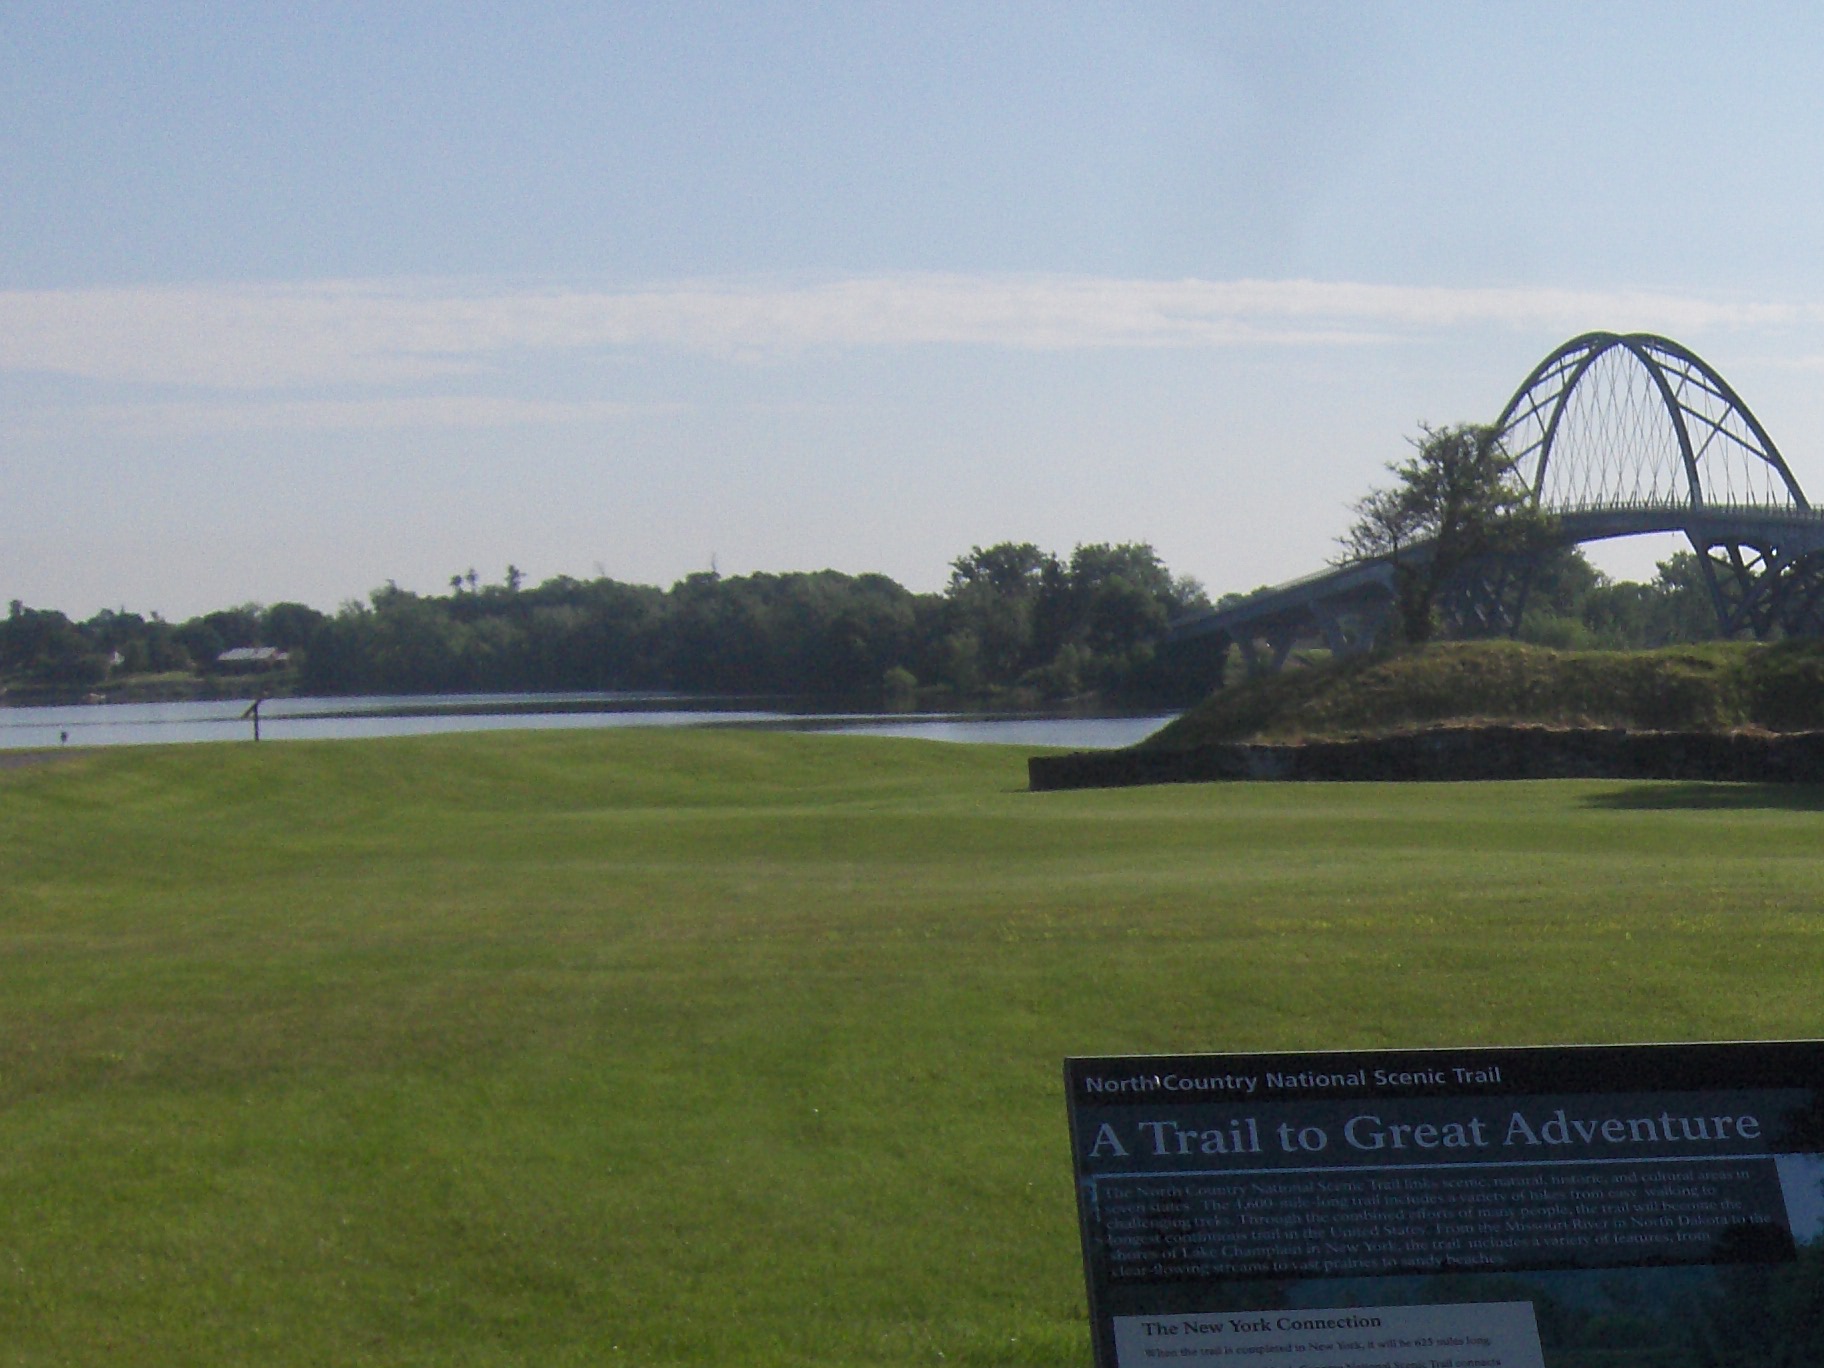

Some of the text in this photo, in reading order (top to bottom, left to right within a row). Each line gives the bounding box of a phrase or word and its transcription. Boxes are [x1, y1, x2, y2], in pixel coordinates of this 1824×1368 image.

[1086, 1065, 1501, 1093] North Country National Scenic Trail
[1088, 1109, 1761, 1158] A Trail to Great Adventure
[1105, 1176, 1547, 1199] The North Country National Scenic Trail links scenic, natural,
[1142, 1314, 1383, 1336] The New York Connection
[1144, 1346, 1178, 1358] When
[1180, 1345, 1198, 1357] the
[1200, 1345, 1222, 1356] trail
[1224, 1344, 1233, 1355] is
[1236, 1342, 1292, 1357] completed
[1295, 1342, 1306, 1353] in
[1308, 1341, 1334, 1352] New
[1338, 1339, 1365, 1352] York,
[1367, 1339, 1375, 1349] it
[1378, 1338, 1397, 1349] will
[1400, 1338, 1411, 1348] be
[1436, 1335, 1464, 1346] miles
[1455, 1358, 1502, 1368] connects
